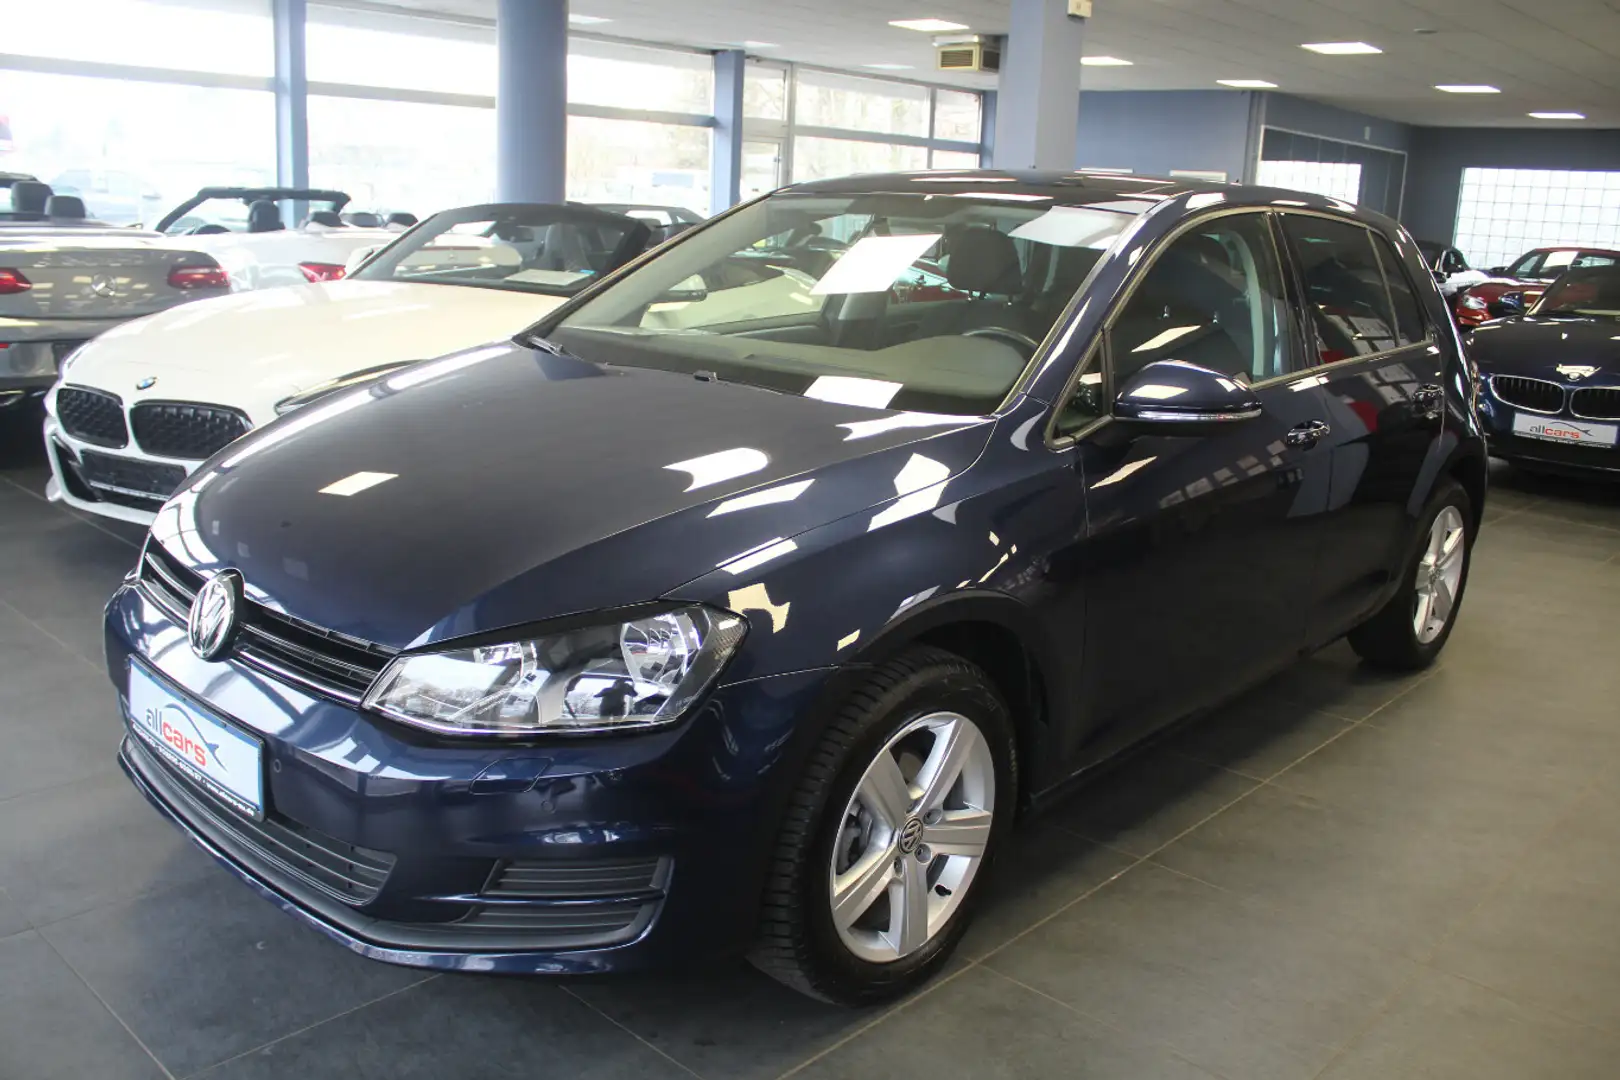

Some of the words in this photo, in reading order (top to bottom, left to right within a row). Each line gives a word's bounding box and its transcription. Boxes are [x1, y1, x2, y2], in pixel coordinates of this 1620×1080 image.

[1529, 425, 1581, 439] allcars
[145, 708, 206, 767] allcars
[899, 817, 923, 852] VW
